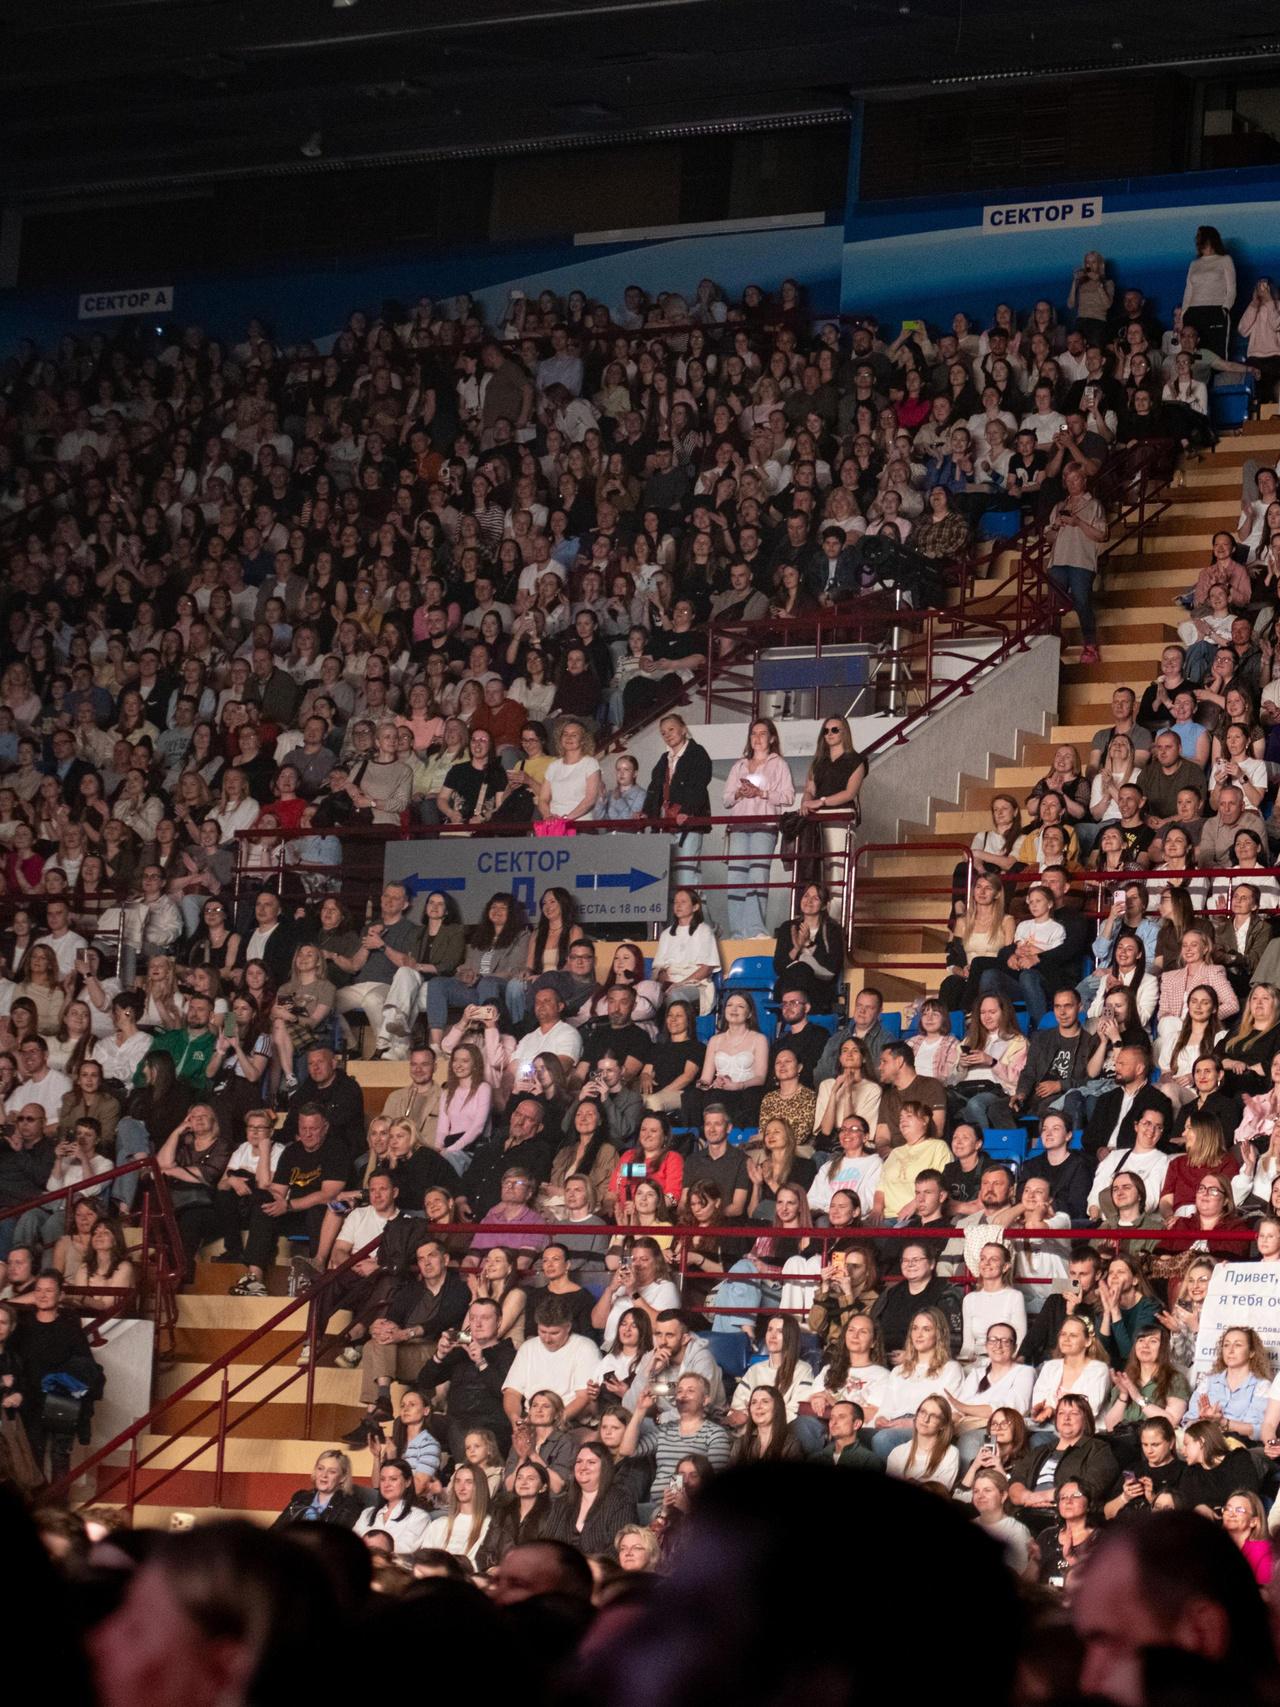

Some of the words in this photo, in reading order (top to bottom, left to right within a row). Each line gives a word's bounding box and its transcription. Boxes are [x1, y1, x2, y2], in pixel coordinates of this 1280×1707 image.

[990, 204, 1074, 226] СЕКТОР
[1081, 202, 1095, 218] Б
[84, 292, 150, 312] СЕКТОР
[155, 290, 167, 305] А
[477, 850, 570, 873] СЕКТОР
[511, 876, 537, 917] Д
[577, 903, 607, 914] ЕСТА
[619, 903, 631, 914] 18
[633, 905, 647, 914] по
[649, 903, 662, 913] 46
[1224, 1270, 1279, 1285] Привет,
[1219, 1295, 1228, 1305] я
[1232, 1294, 1263, 1306] тебя
